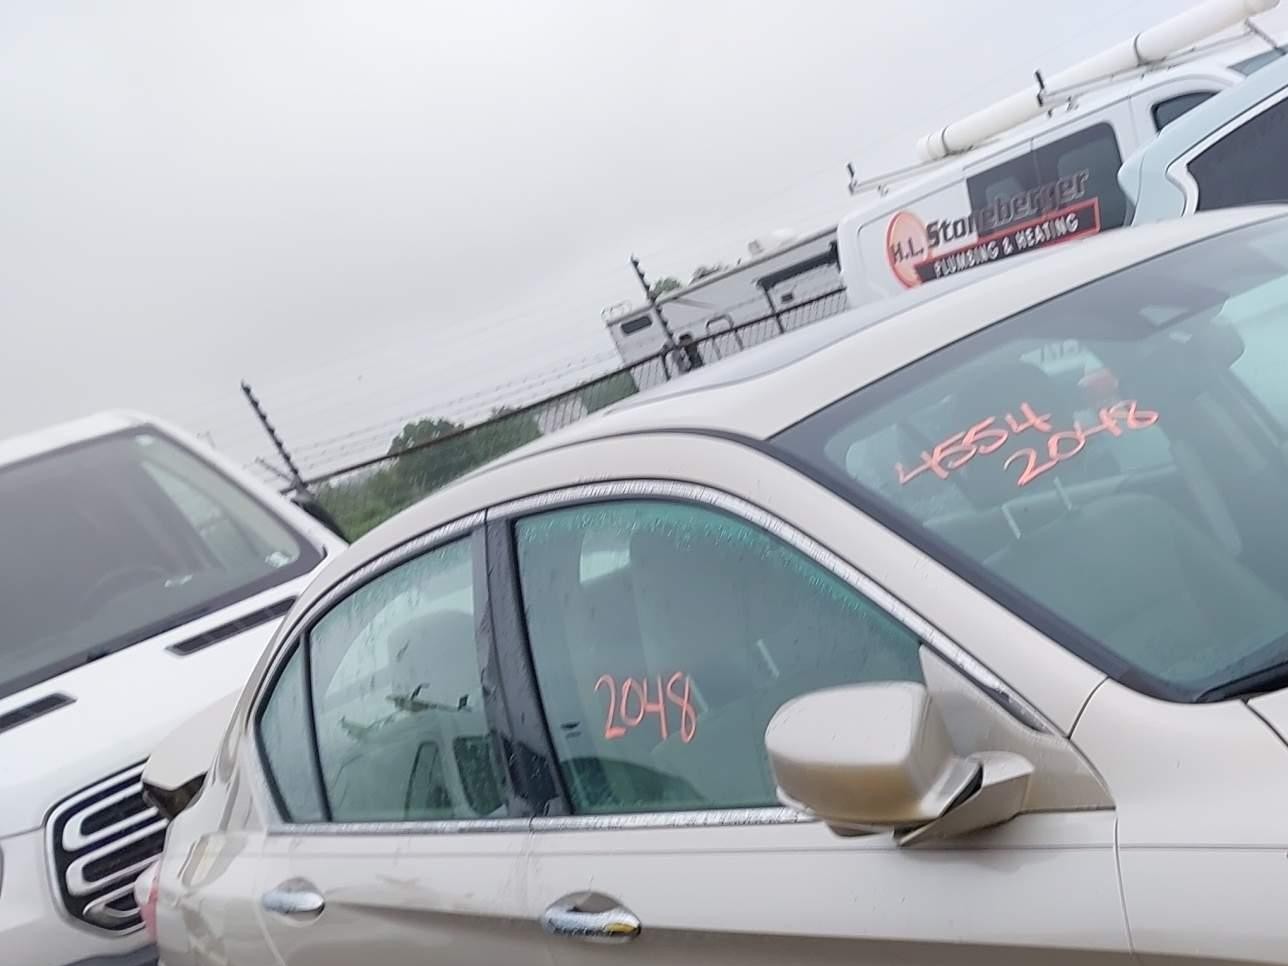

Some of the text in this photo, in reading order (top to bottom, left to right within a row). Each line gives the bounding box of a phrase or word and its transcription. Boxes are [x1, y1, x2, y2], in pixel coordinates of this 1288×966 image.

[933, 240, 999, 278] PLUMBING
[1015, 213, 1079, 250] HEATING
[895, 402, 1052, 485] 4554
[1003, 401, 1160, 486] 2048
[593, 671, 697, 743] 2048
